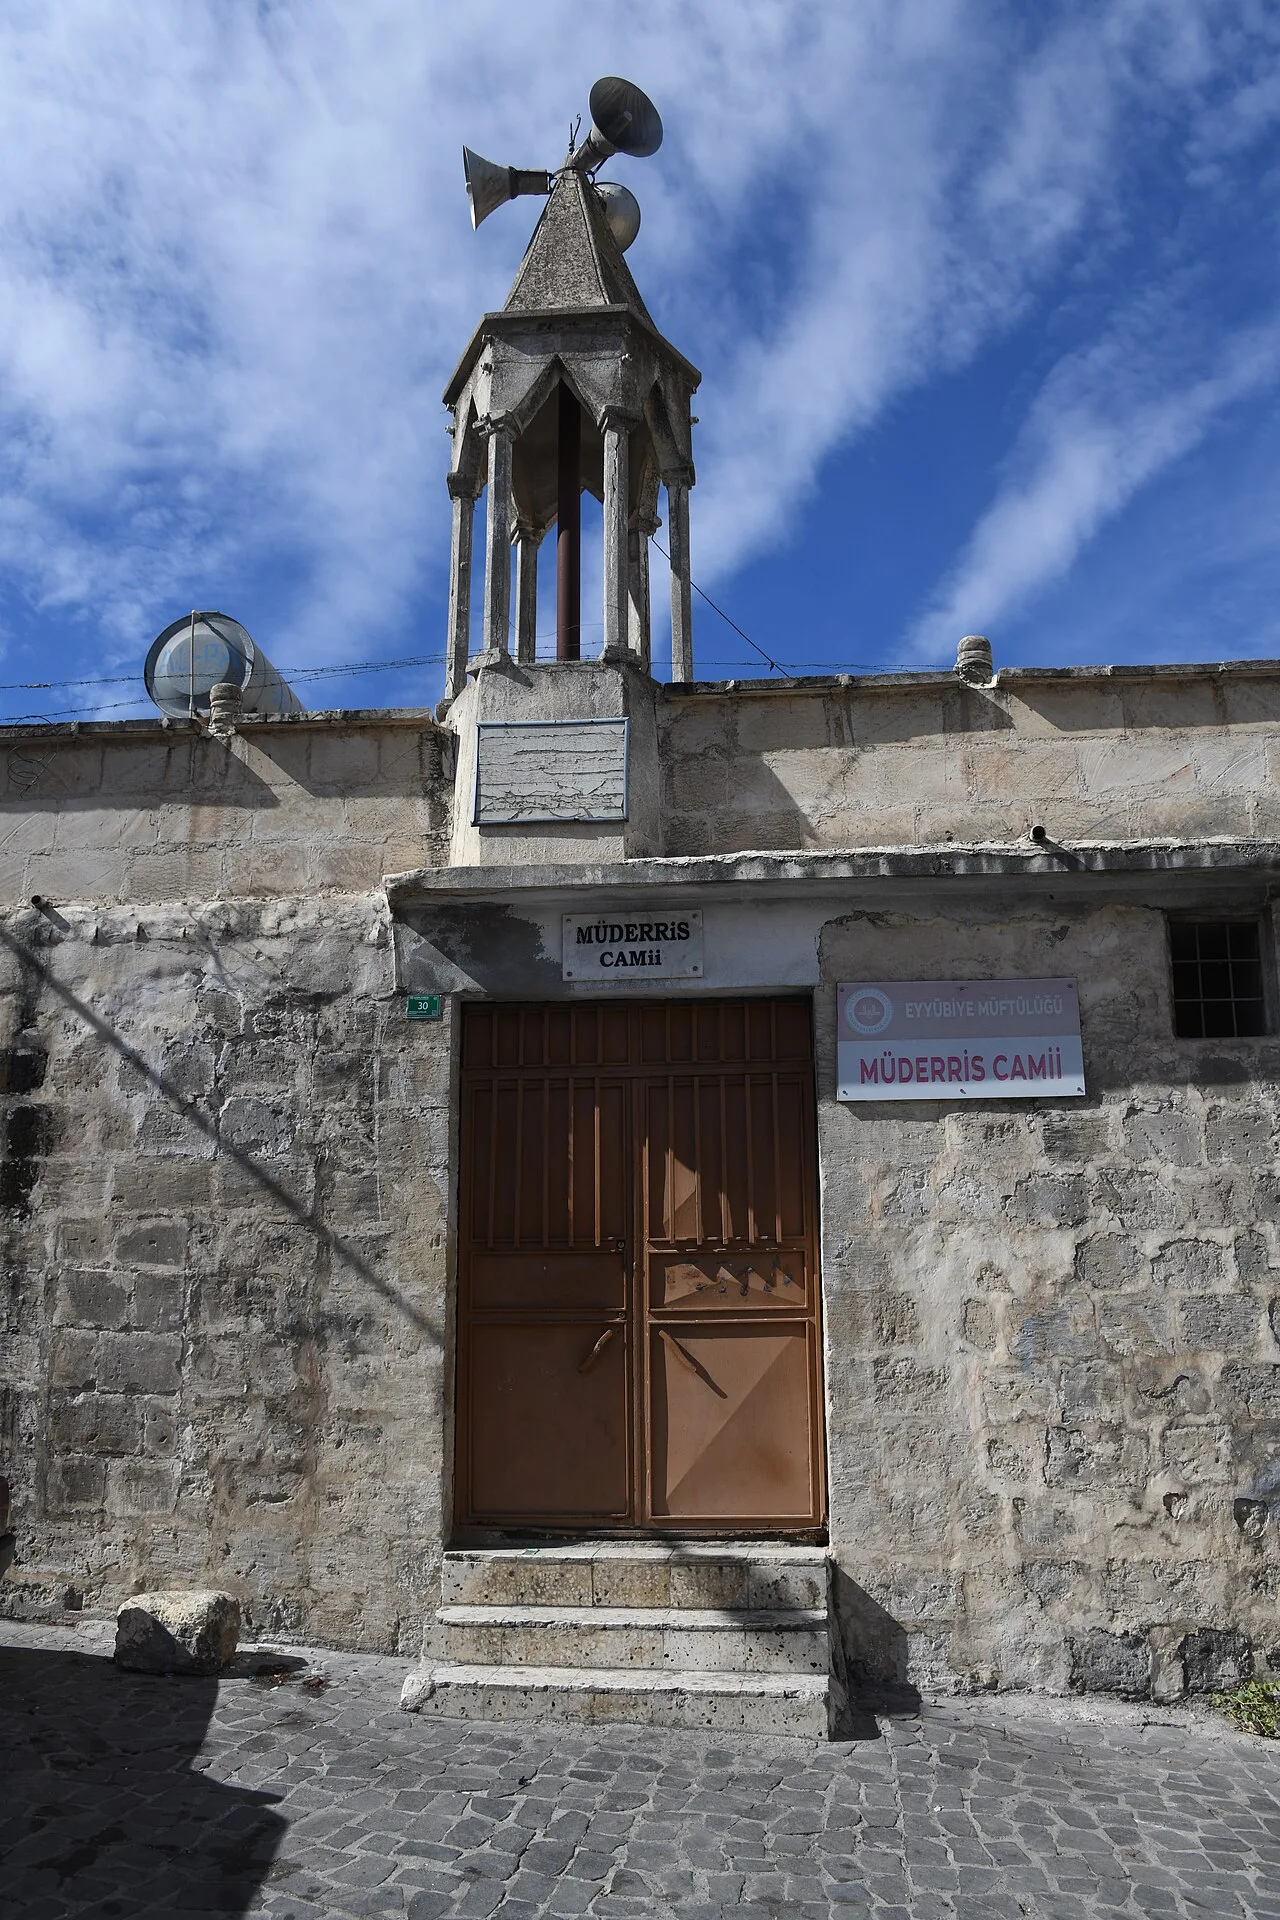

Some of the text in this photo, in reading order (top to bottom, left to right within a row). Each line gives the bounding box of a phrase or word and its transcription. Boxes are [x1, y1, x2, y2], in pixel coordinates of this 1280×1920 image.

[417, 1001, 429, 1010] 30
[905, 997, 975, 1019] EYYÜBİYE
[978, 994, 1063, 1016] MÜFTÜLÜĞÜ
[859, 1046, 1062, 1085] MÜDERRİS CAMİİ
